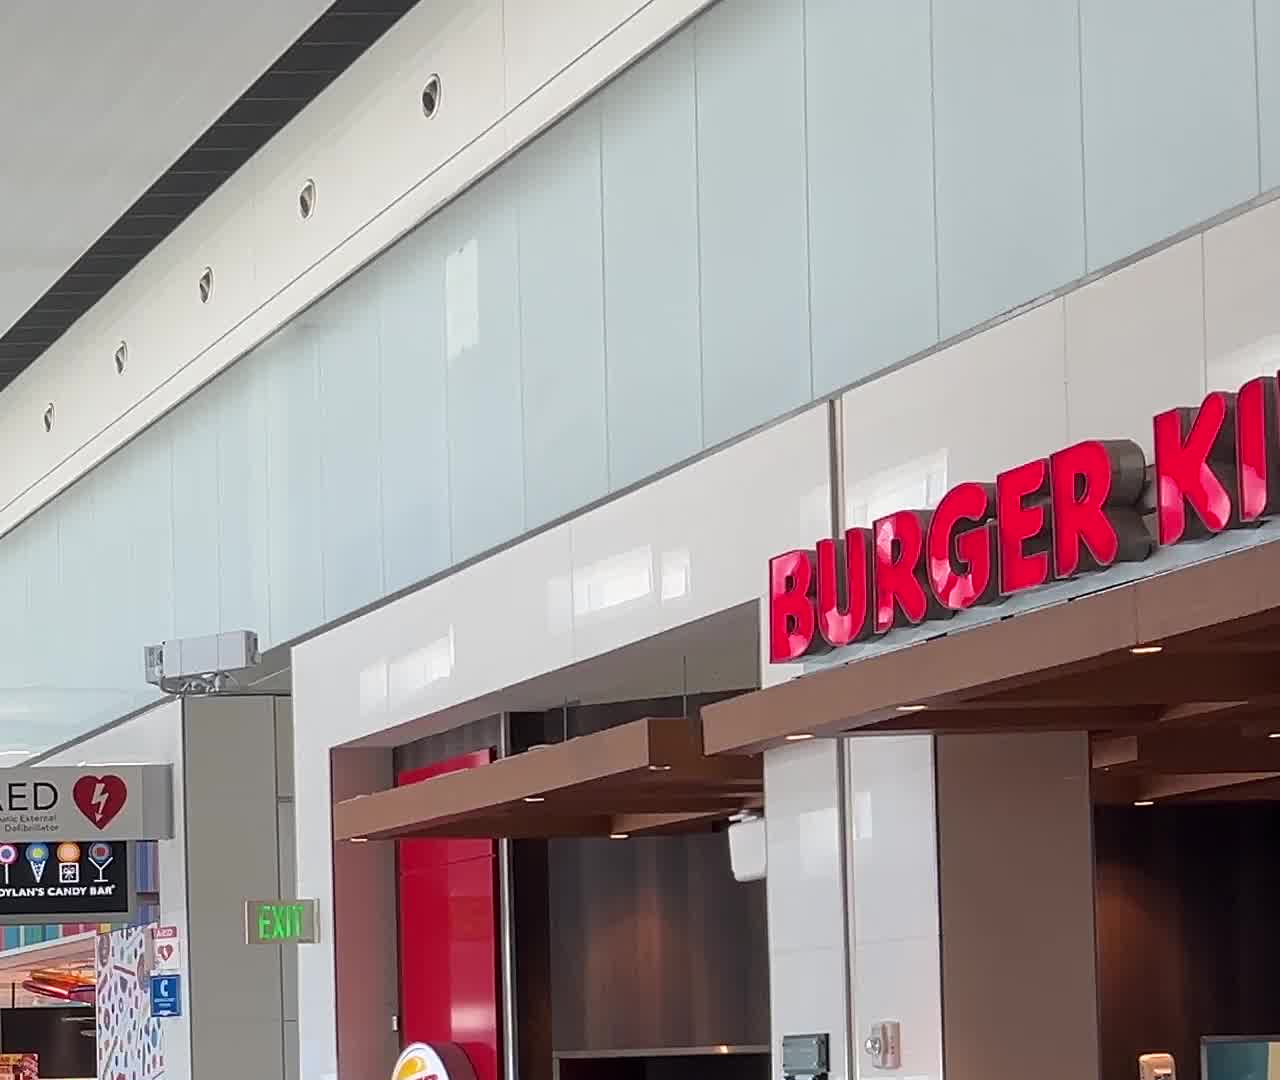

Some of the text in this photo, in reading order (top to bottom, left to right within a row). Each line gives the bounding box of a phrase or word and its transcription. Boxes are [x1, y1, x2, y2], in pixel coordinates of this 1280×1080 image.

[769, 369, 1280, 664] BURGER KI
[20, 814, 56, 823] External
[47, 886, 87, 896] CANDY
[90, 885, 113, 896] BAR
[258, 904, 305, 940] EXIT
